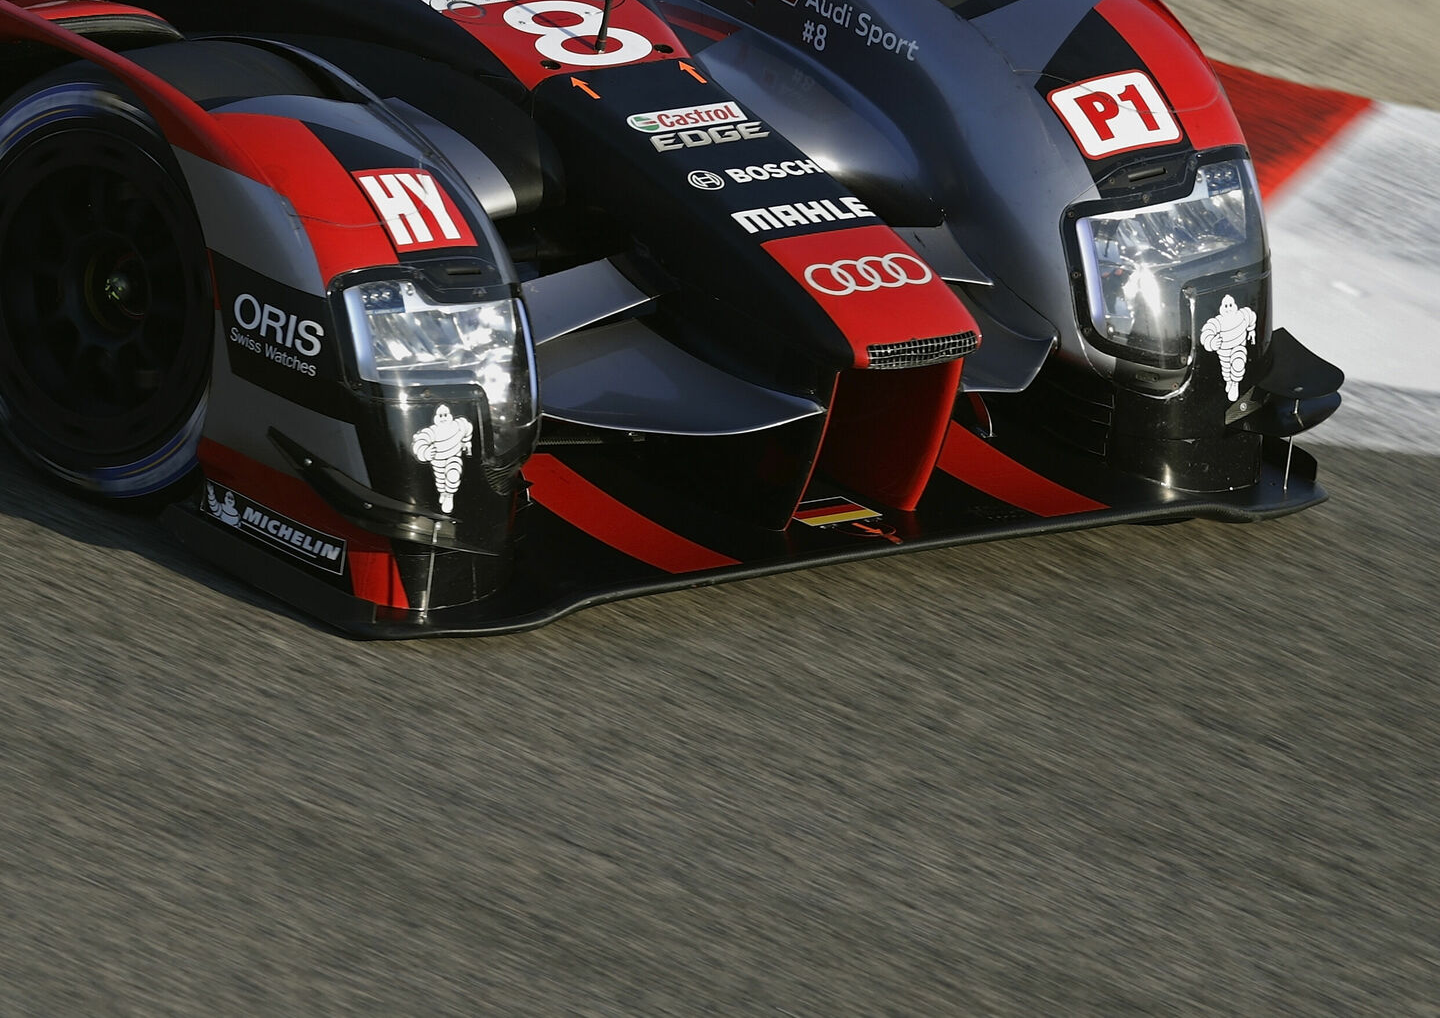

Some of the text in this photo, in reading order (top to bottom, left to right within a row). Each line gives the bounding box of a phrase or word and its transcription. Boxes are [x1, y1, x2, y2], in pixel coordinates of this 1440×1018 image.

[503, 0, 653, 66] 8
[802, 20, 828, 52] #8
[855, 12, 920, 62] Sport
[649, 121, 771, 153] EDGE
[658, 104, 739, 128] Castrol
[1074, 84, 1160, 142] P1
[725, 158, 826, 184] BOSCH
[358, 173, 462, 245] HY
[730, 196, 877, 235] MAHLE
[233, 292, 325, 358] ORIS
[230, 329, 317, 377] Swiss Watches
[241, 507, 342, 562] MICHELIN
